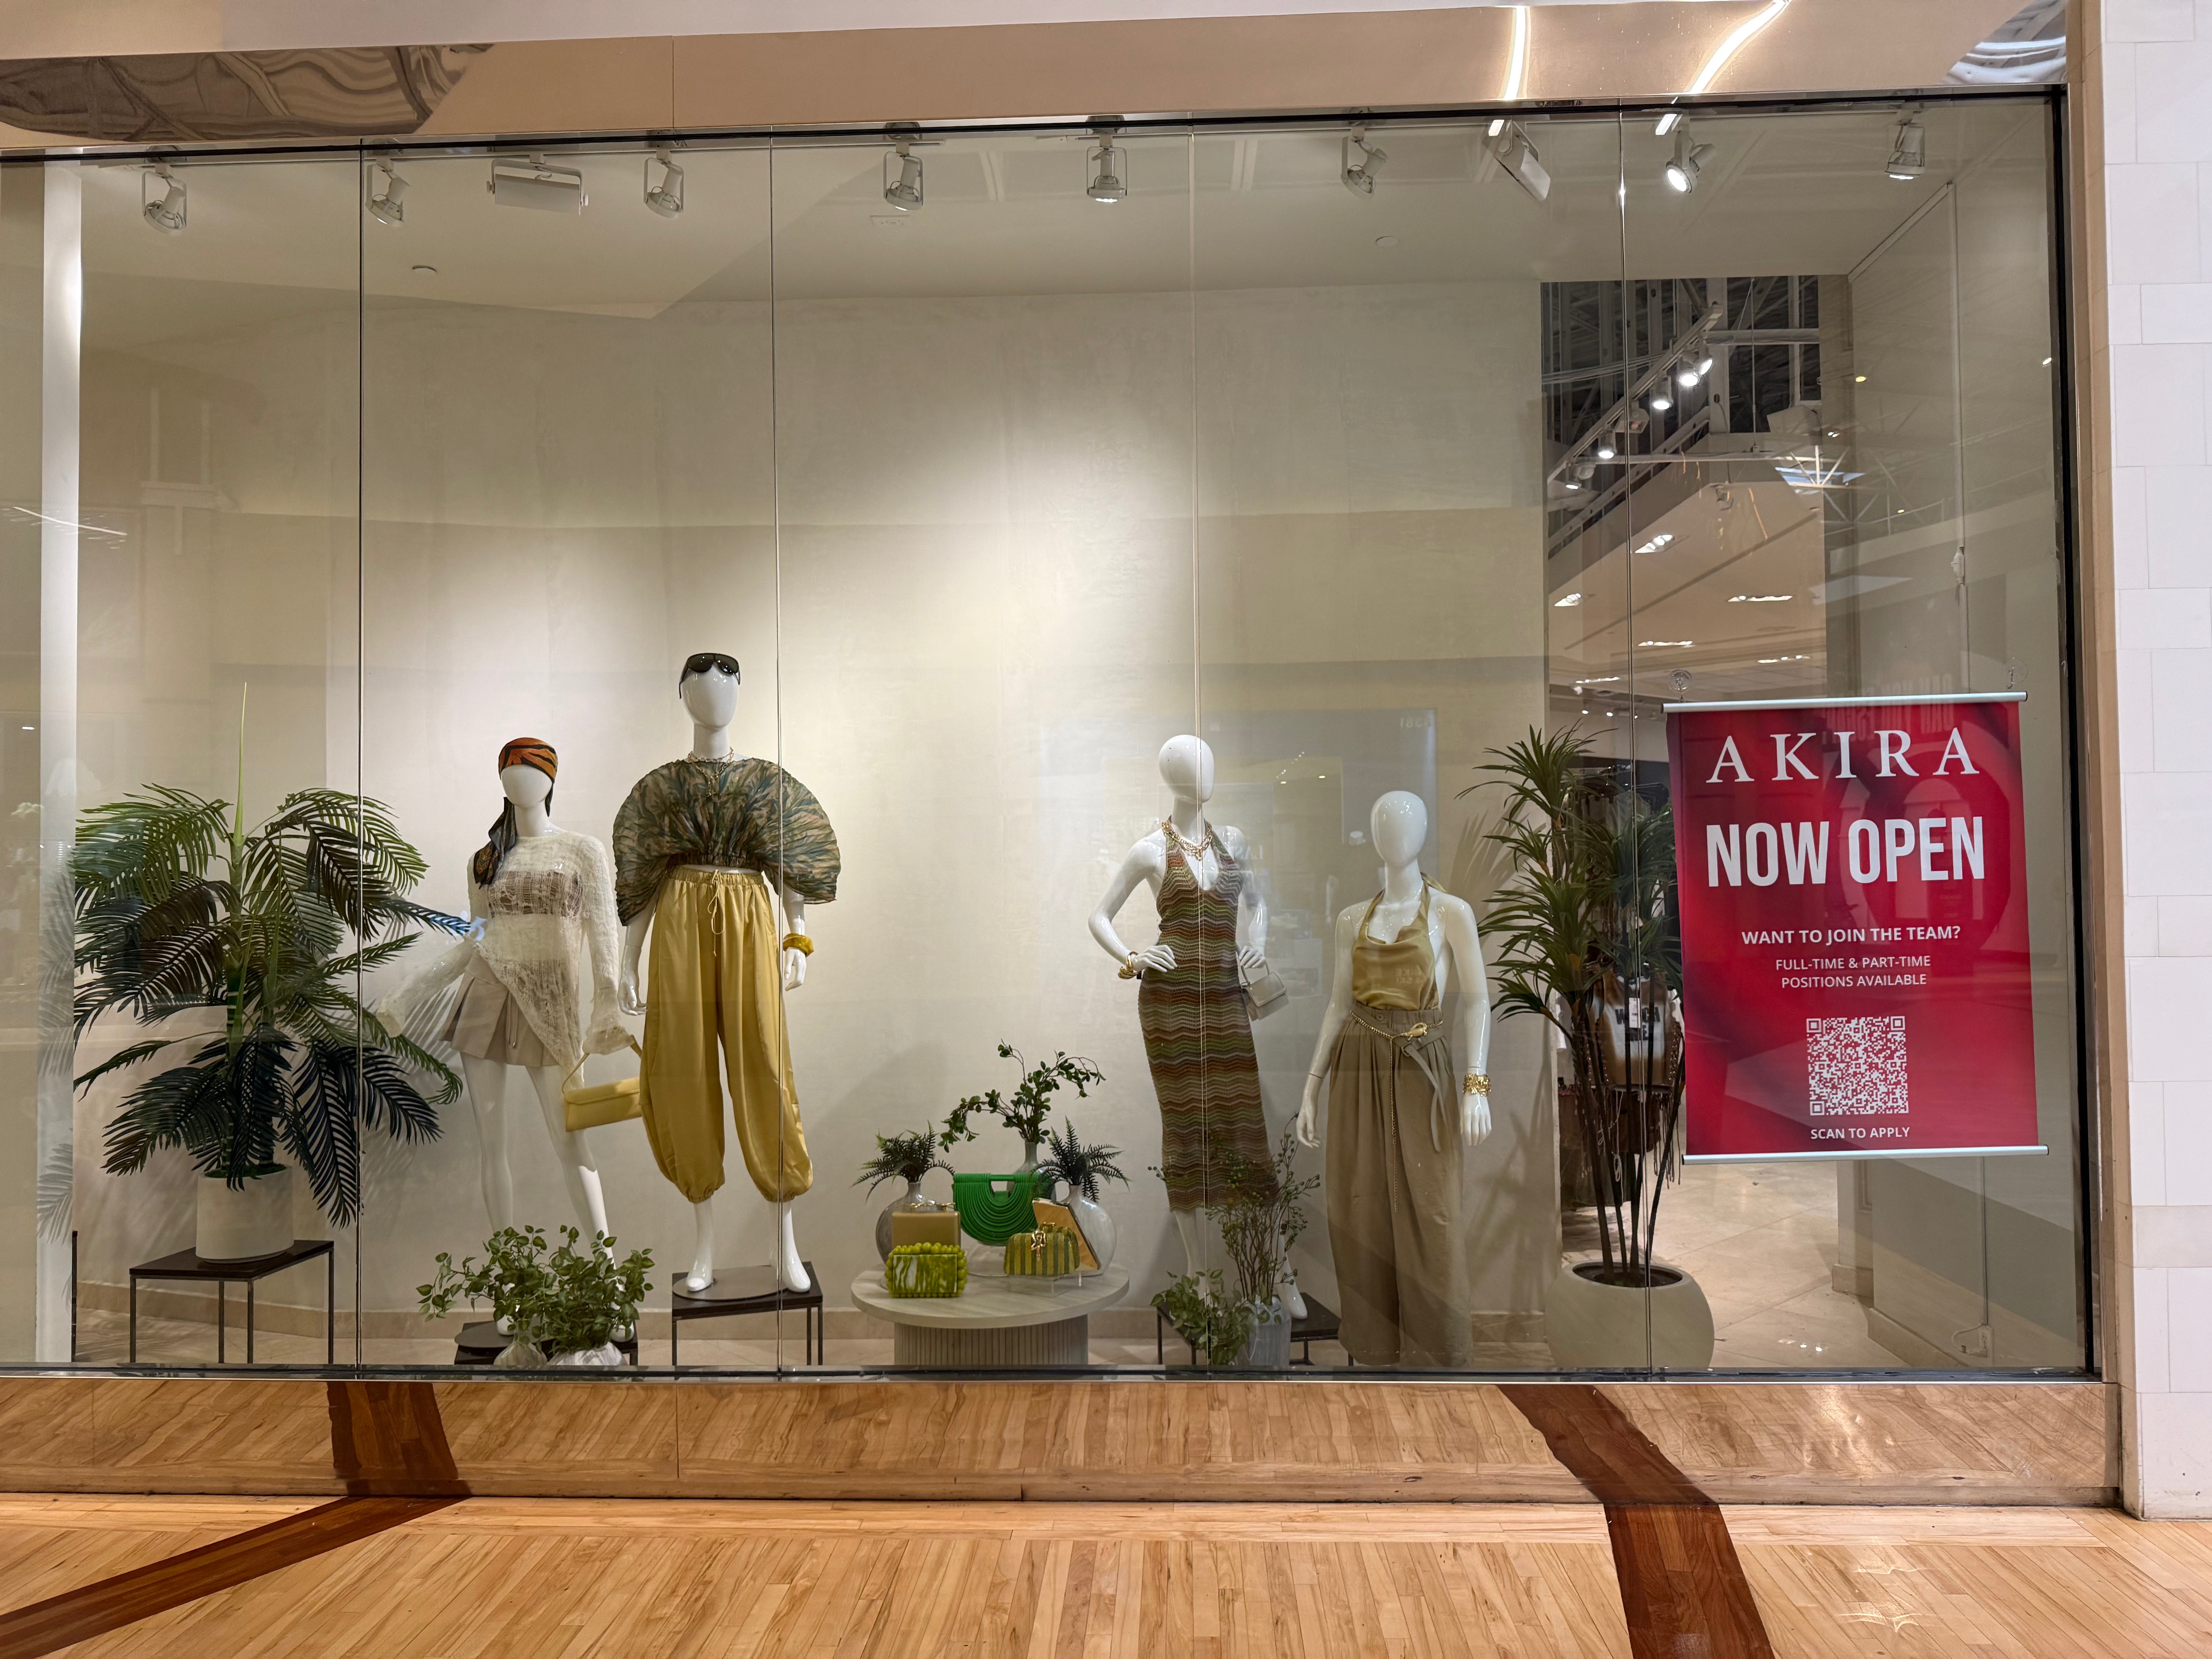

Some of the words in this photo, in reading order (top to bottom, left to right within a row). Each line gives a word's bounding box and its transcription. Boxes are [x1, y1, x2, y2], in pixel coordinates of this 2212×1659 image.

[1706, 727, 1980, 783] AKIRA
[1706, 821, 1829, 887] NOW
[1848, 816, 1984, 883] OPEN
[1741, 931, 1795, 944] WANT
[1799, 930, 1822, 943] TO
[1826, 929, 1865, 946] JOIN
[1870, 927, 1902, 941] THE
[1906, 926, 1960, 940] TEAM?
[1776, 958, 1844, 970] FULL-TIME
[1849, 958, 1858, 969] &
[1862, 955, 1930, 968] PART-TIME
[1782, 976, 1853, 988] POSITIONS
[1857, 974, 1927, 986] AVAILABLE
[1615, 1006, 1661, 1024] WCH
[1811, 1128, 1845, 1139] SCAN
[1848, 1128, 1866, 1138] TO
[1870, 1127, 1910, 1138] APPLY
